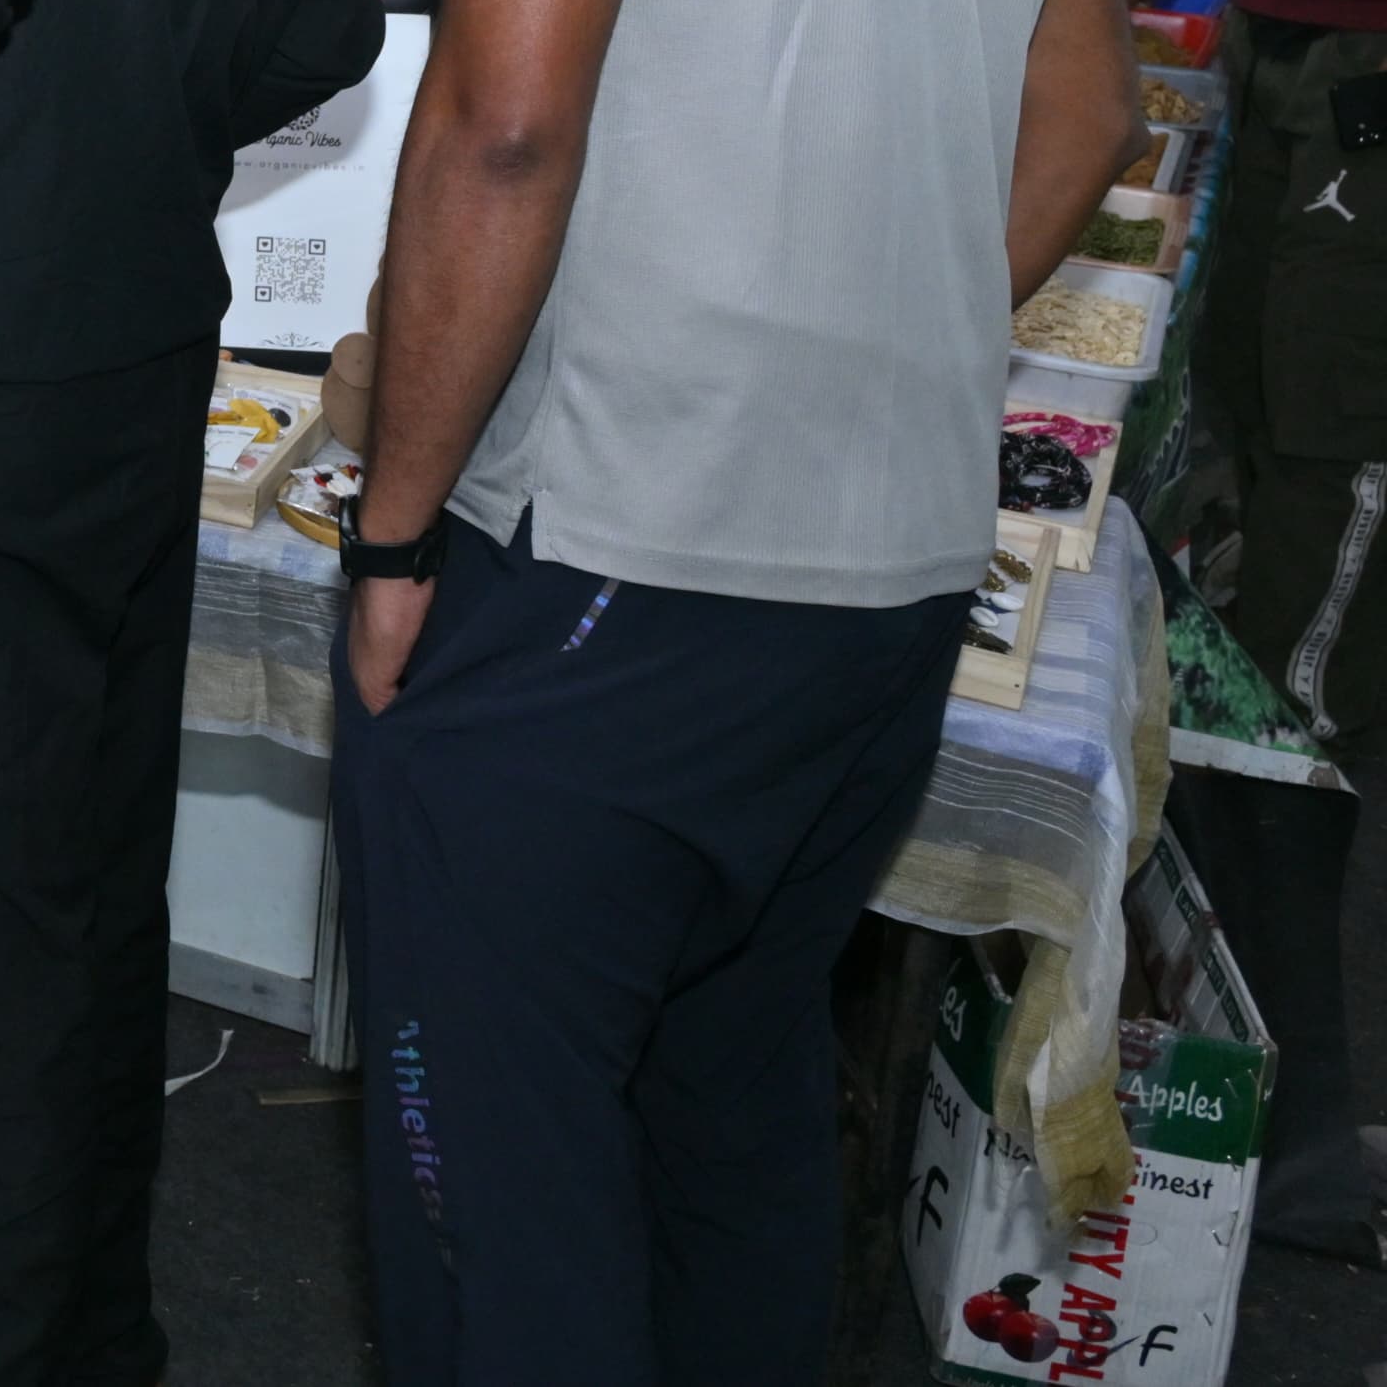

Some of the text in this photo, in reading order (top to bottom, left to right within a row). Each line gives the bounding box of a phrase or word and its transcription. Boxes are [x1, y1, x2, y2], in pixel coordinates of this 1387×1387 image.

[305, 131, 342, 148] Vibes
[1128, 1074, 1223, 1122] Apples
[1136, 1162, 1215, 1200] inest
[1048, 1282, 1118, 1386] APPL
